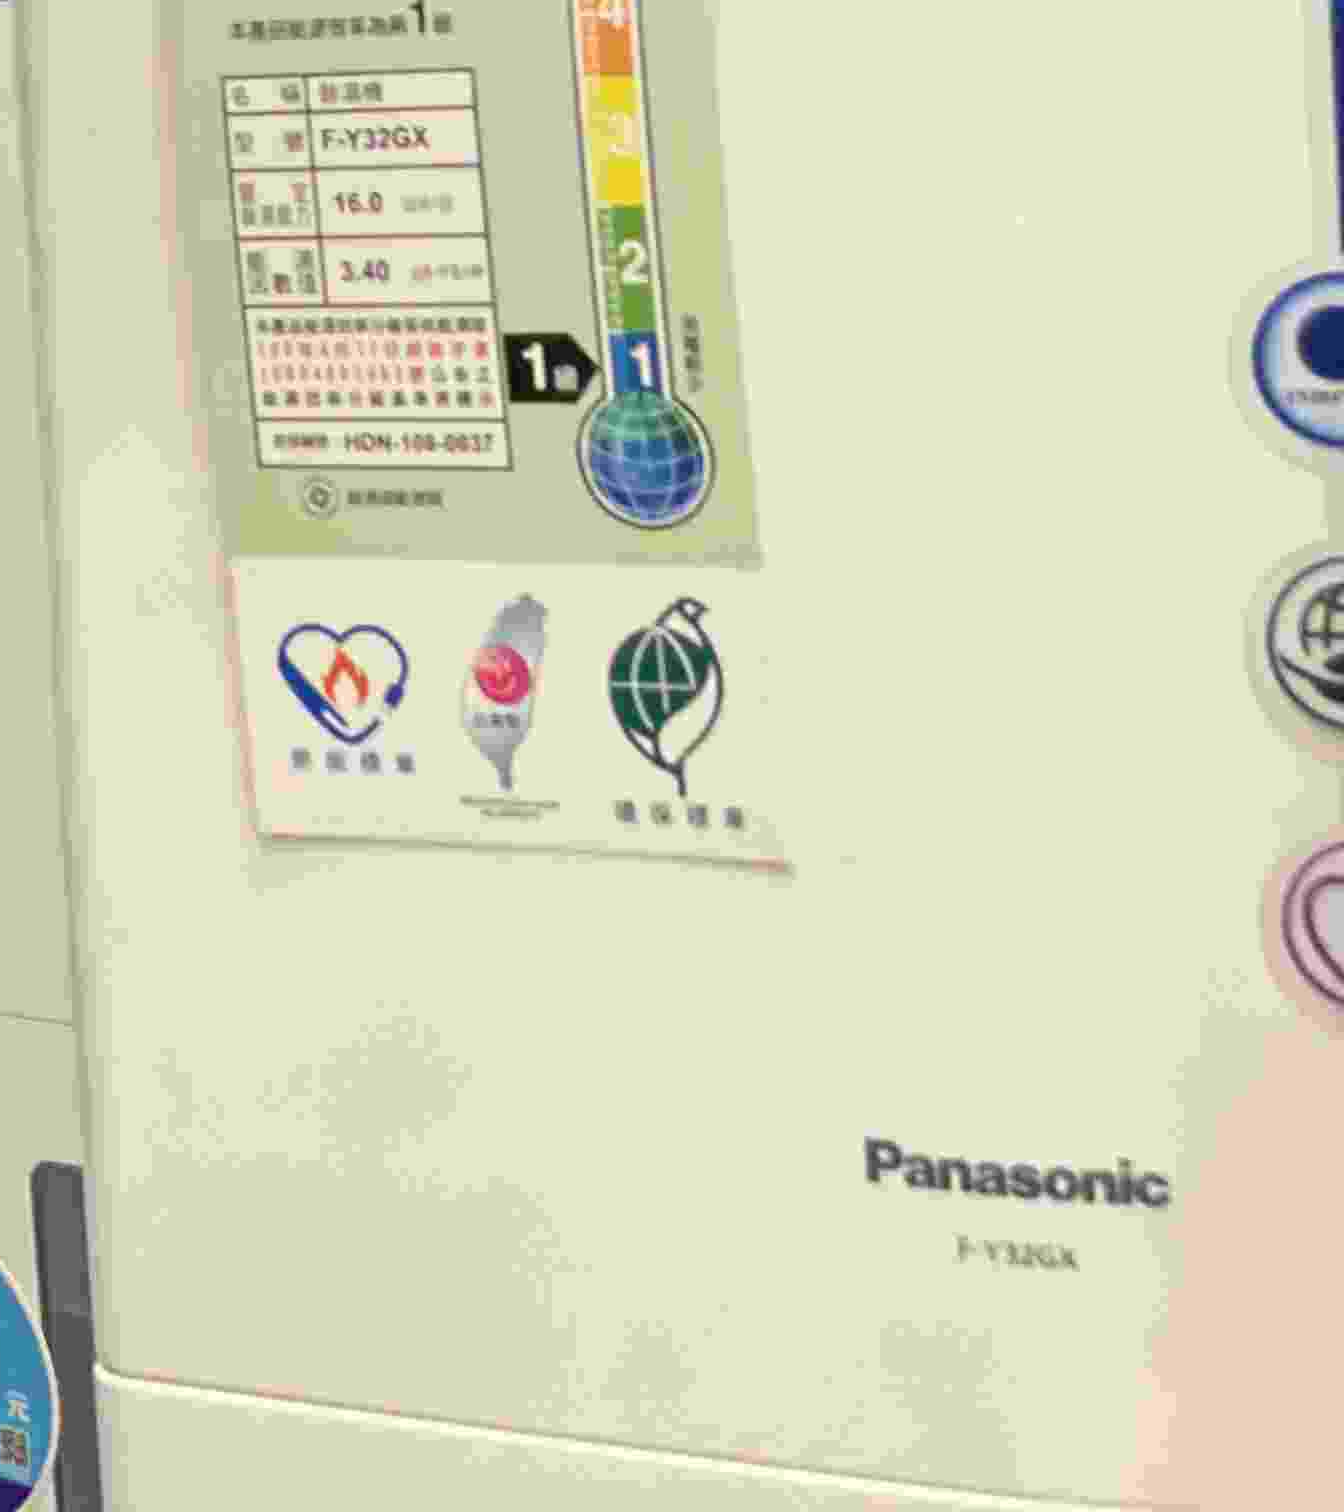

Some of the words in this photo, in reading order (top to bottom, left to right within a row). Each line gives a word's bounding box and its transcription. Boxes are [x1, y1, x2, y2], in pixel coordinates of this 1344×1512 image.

[334, 191, 384, 215] 16.0
[618, 241, 650, 285] 2
[521, 341, 548, 392] 1
[630, 342, 653, 388] 1
[864, 1136, 1171, 1208] Panasonic
